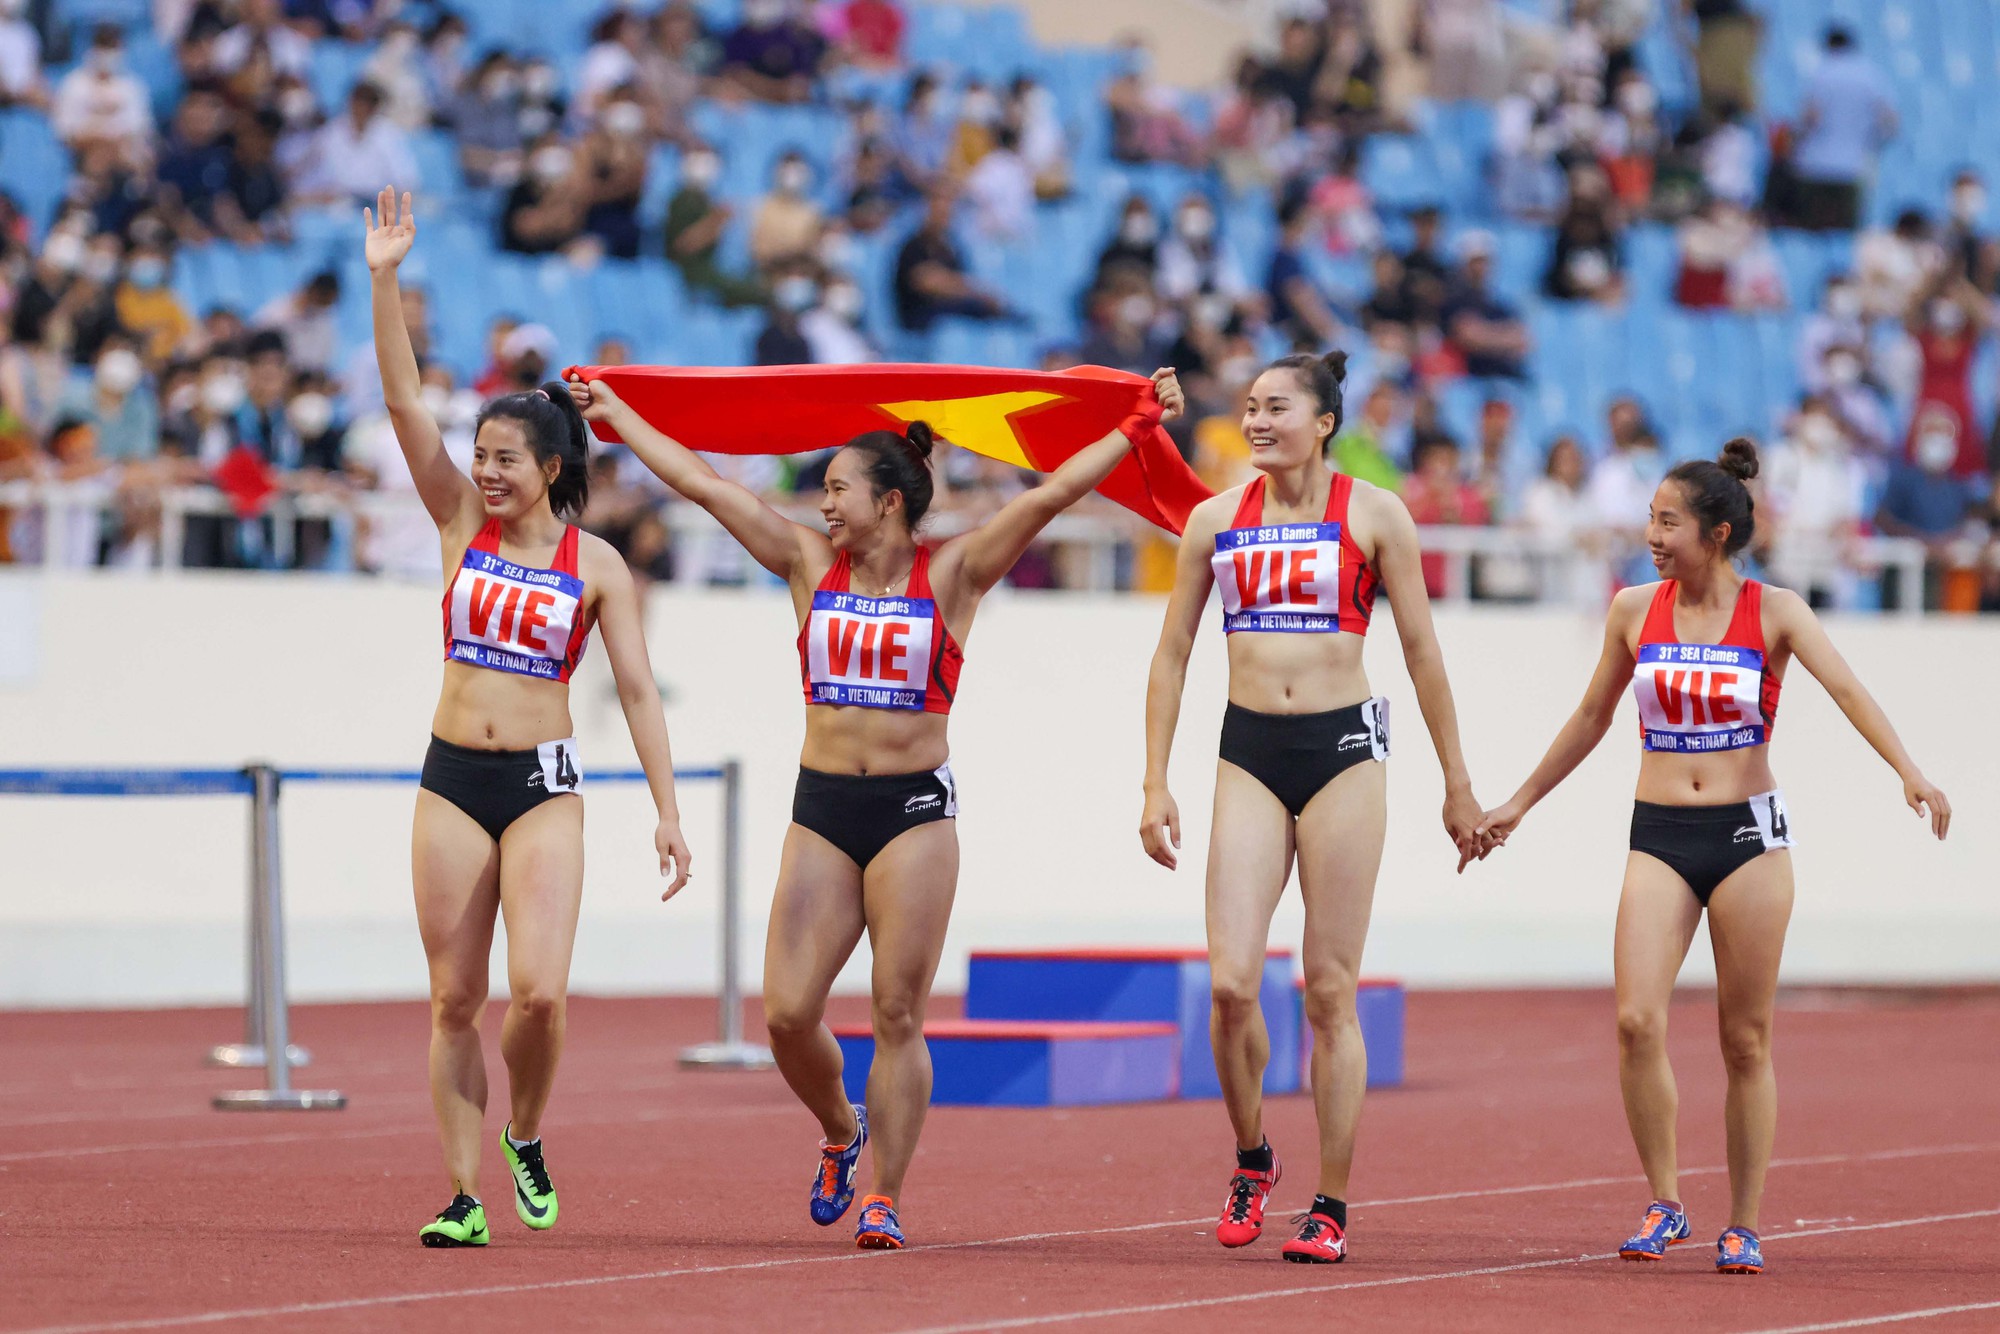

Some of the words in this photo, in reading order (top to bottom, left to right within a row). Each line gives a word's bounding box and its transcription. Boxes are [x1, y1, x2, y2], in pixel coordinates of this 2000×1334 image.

[1258, 528, 1279, 542] SEA
[1282, 527, 1318, 540] Games
[502, 564, 524, 579] SEA
[526, 570, 561, 586] Games
[1233, 548, 1318, 608] VIE
[469, 577, 556, 651] VIE
[855, 598, 876, 614] SEA
[878, 601, 910, 614] Games
[1260, 615, 1303, 629] VIETNAM
[1305, 616, 1330, 629] 2022
[828, 618, 910, 681] VIE
[1680, 647, 1700, 660] SEA
[1703, 648, 1739, 663] Games
[486, 649, 529, 672] VIETNAM
[531, 659, 552, 675] 2022
[848, 688, 891, 704] VIETNAM
[892, 692, 915, 706] 2022
[1654, 670, 1742, 726] VIE
[1651, 734, 1677, 749] HANOI
[1685, 734, 1729, 750] VIETNAM
[1732, 729, 1755, 746] 2022
[555, 744, 578, 790] 4
[905, 800, 941, 813] LI-NING
[1768, 796, 1787, 843] 4
